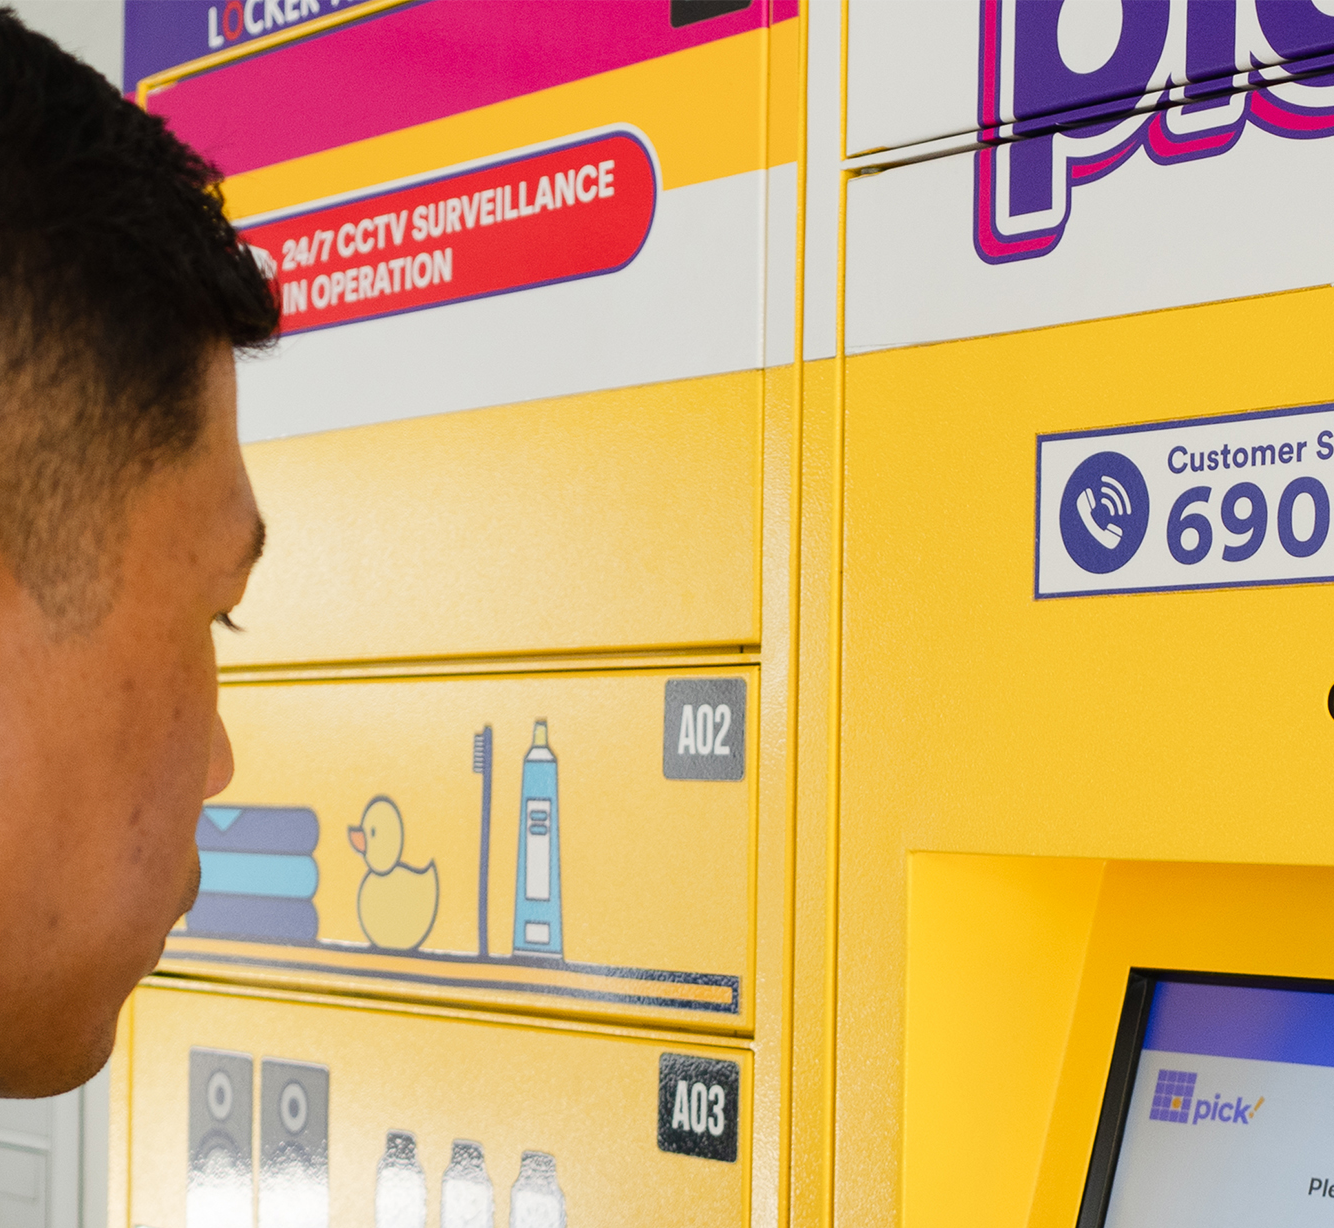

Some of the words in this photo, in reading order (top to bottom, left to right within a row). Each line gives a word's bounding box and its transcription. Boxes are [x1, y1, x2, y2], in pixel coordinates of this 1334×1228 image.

[281, 230, 335, 271] 24/7
[336, 210, 408, 258] CCTV
[411, 160, 615, 241] SURVEILLANCE
[283, 278, 307, 316] IN
[311, 247, 453, 309] OPERATION
[1167, 437, 1308, 475] Customer
[677, 704, 731, 757] A02
[671, 1081, 725, 1138] A03
